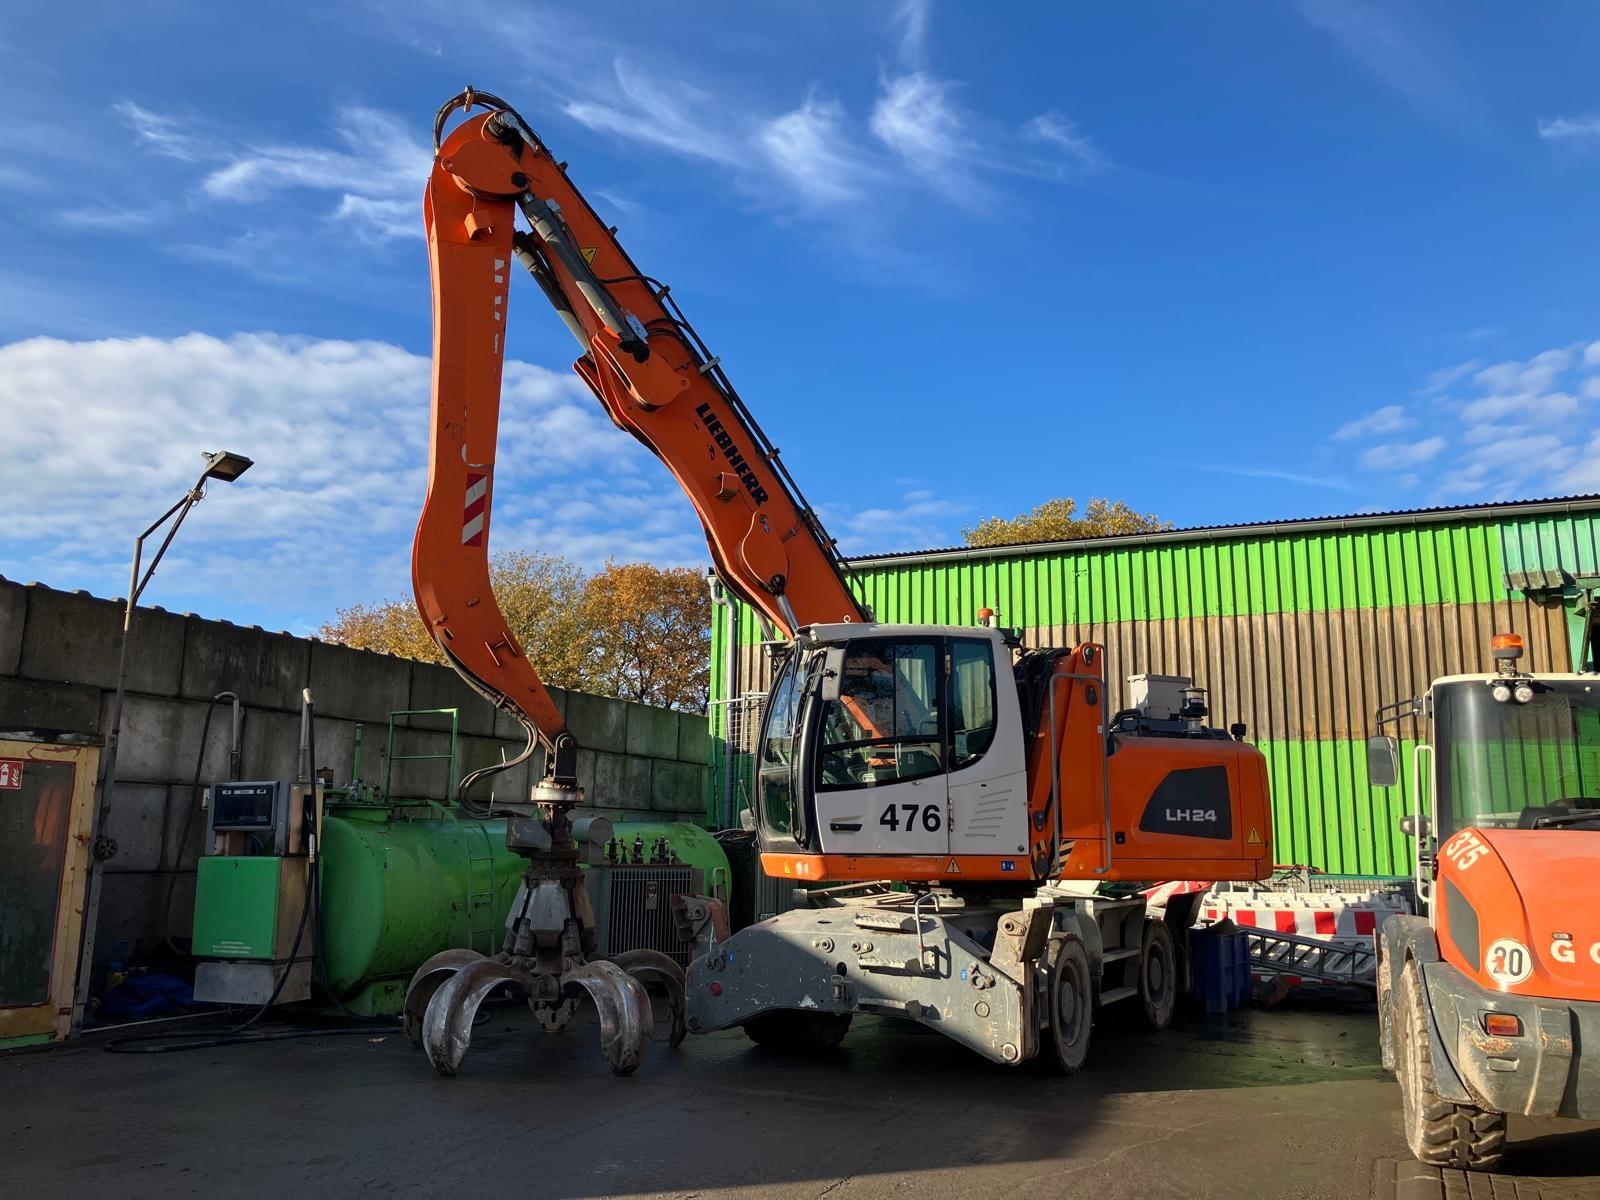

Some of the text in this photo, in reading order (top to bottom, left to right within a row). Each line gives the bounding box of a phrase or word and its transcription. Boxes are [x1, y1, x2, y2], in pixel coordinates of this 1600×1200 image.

[695, 402, 769, 507] LIEBHERR
[880, 803, 941, 832] 476
[1446, 831, 1489, 872] 375
